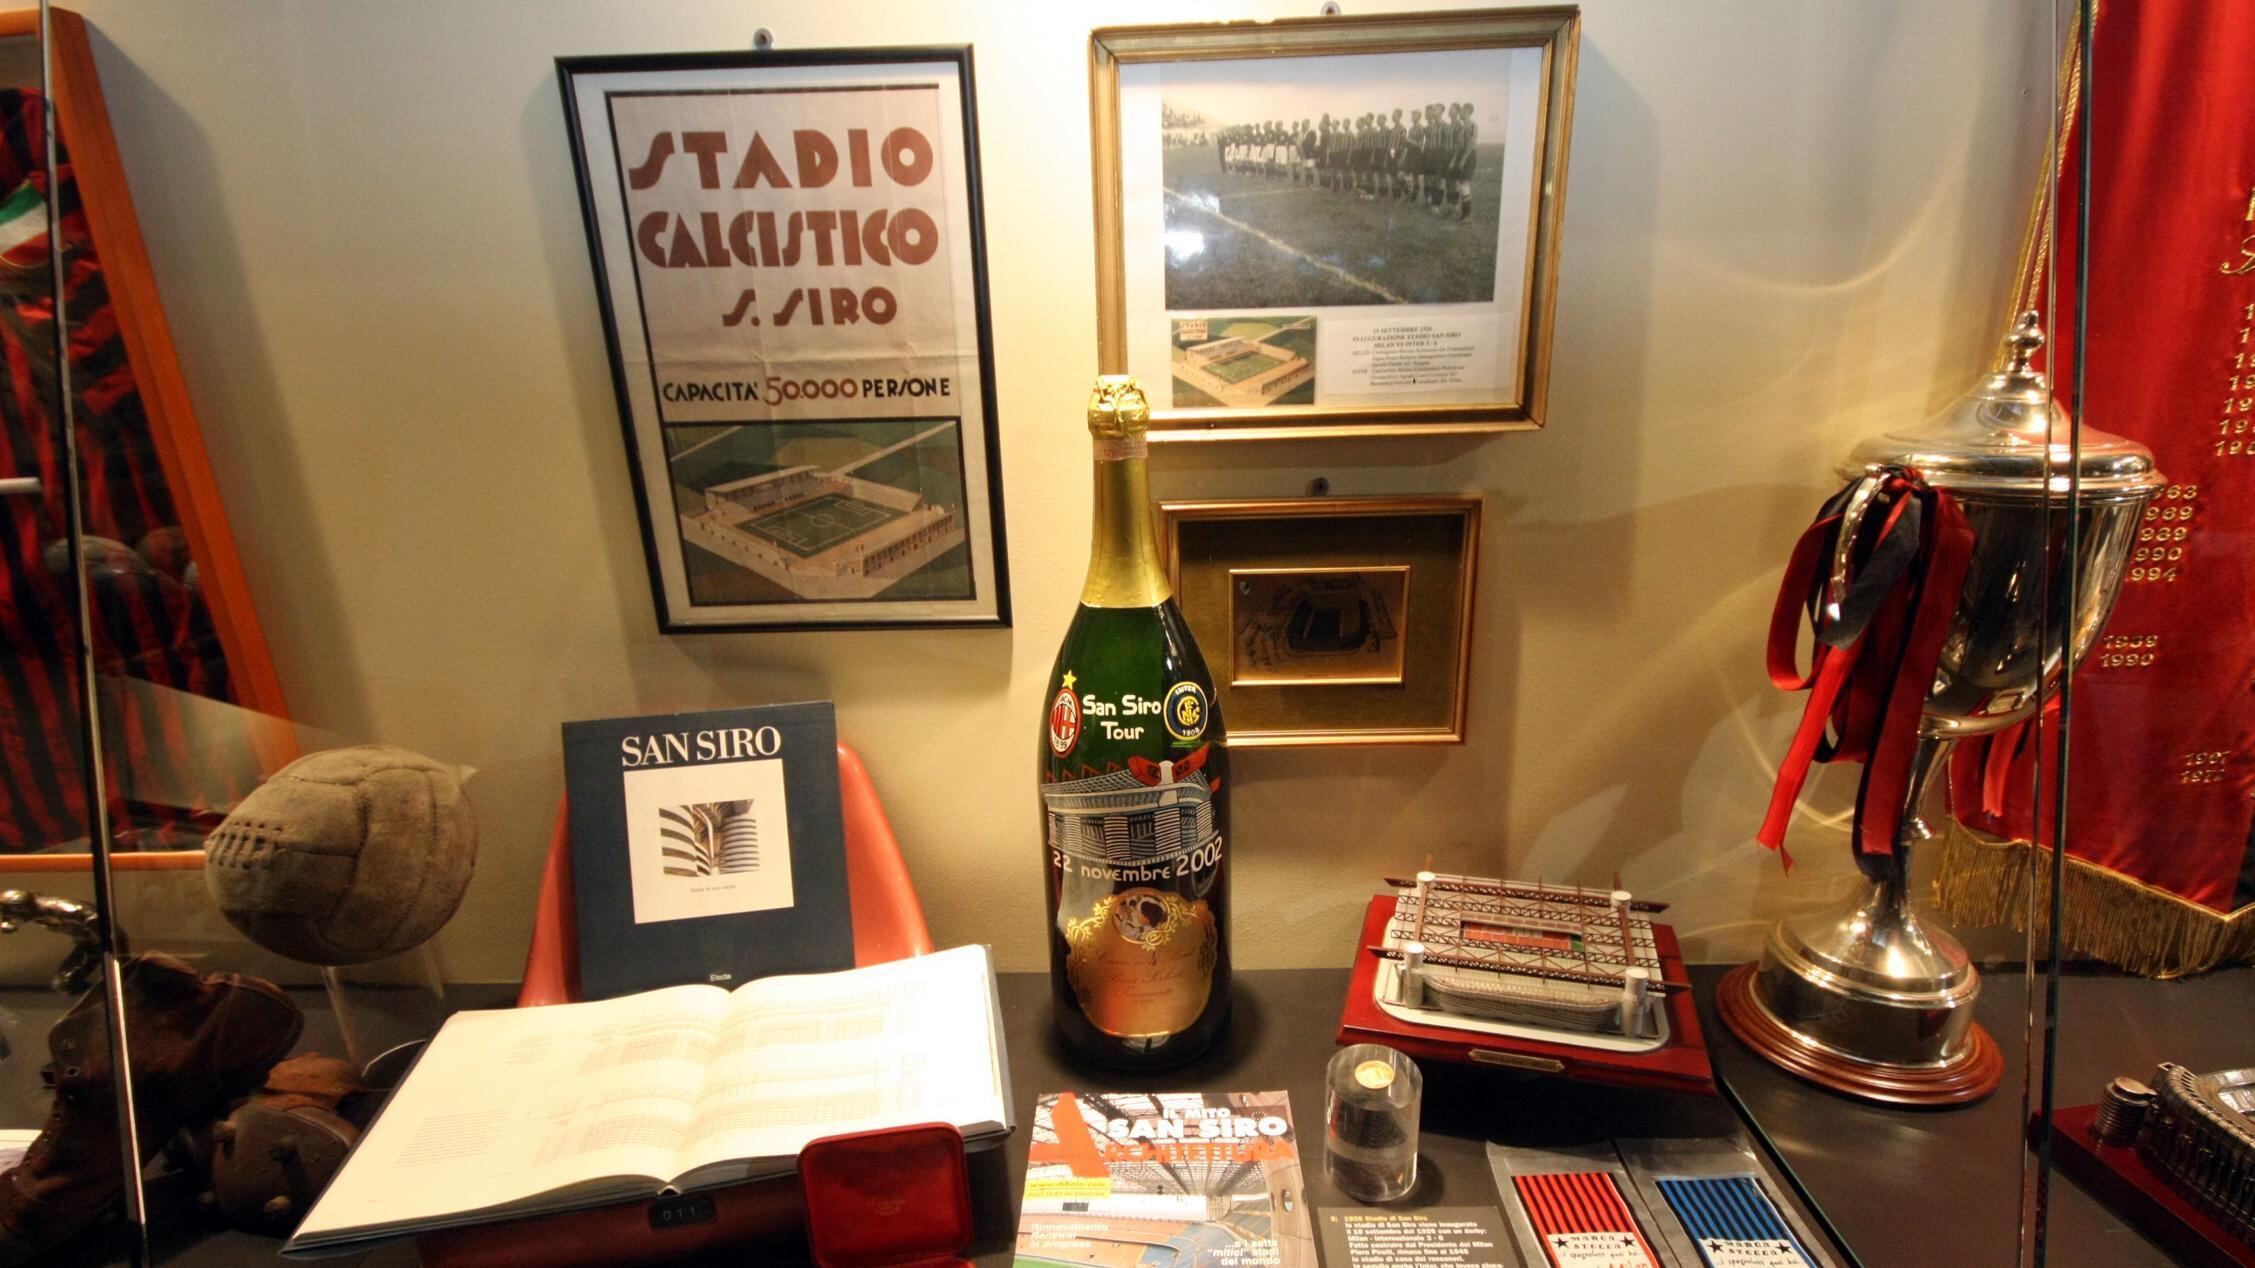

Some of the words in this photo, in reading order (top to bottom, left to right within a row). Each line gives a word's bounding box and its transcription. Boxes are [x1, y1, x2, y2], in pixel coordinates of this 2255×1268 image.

[628, 126, 934, 190] STADIO
[637, 207, 939, 268] CALCISTICO
[722, 288, 762, 327] S.
[773, 286, 898, 326] SIRO
[862, 378, 951, 398] PERSONE
[2145, 506, 2193, 520] 969
[2141, 527, 2187, 541] 989
[2135, 547, 2182, 561] 990
[2131, 567, 2177, 582] 994
[1082, 694, 1117, 716] San
[1122, 694, 1162, 715] Siro
[1100, 721, 1145, 740] Tour
[621, 732, 693, 767] SAN
[696, 726, 782, 761] SIRO
[1053, 851, 1073, 872] 22
[1081, 863, 1171, 882] novembre
[1175, 836, 1223, 876] 2002
[1184, 1107, 1231, 1119] MITO
[1108, 1118, 1185, 1139] SAN
[1200, 1116, 1288, 1138] SIRO
